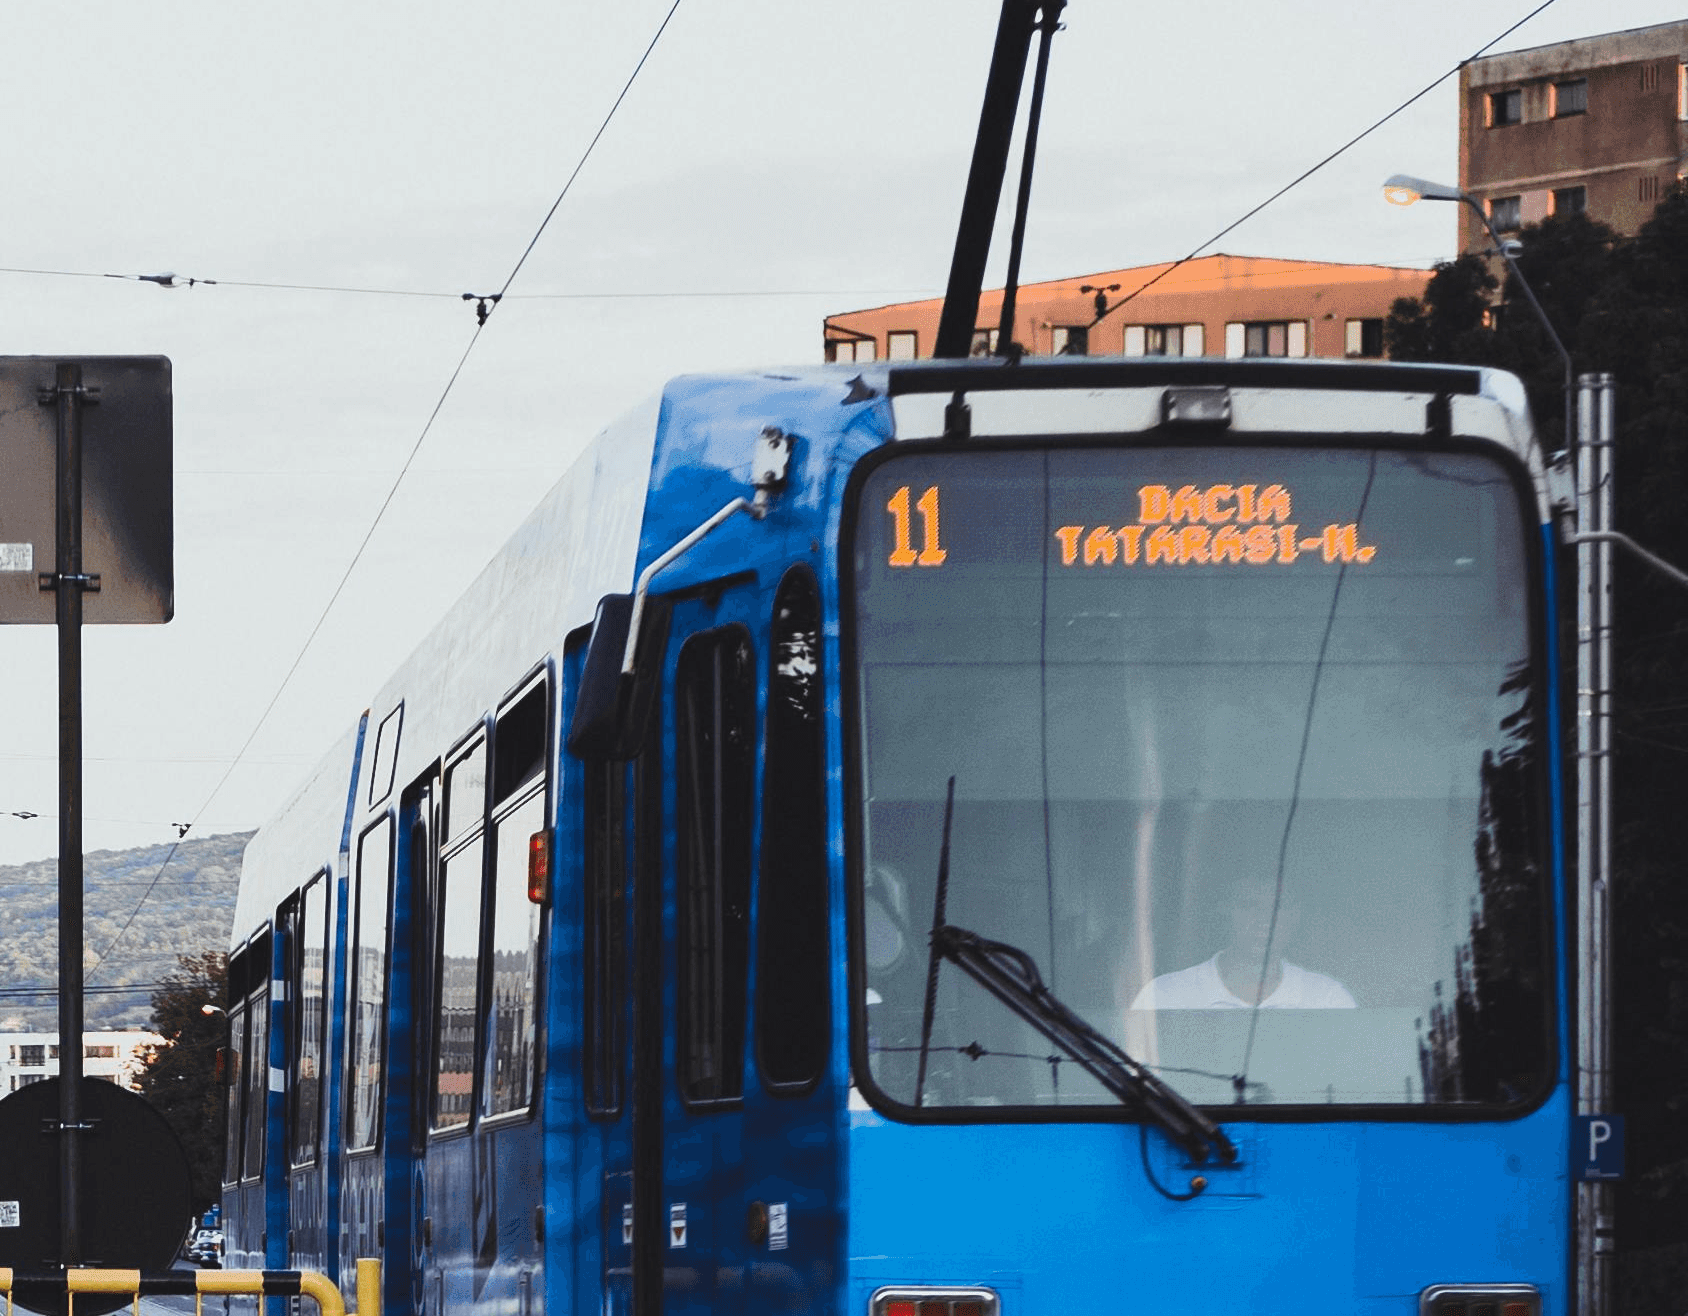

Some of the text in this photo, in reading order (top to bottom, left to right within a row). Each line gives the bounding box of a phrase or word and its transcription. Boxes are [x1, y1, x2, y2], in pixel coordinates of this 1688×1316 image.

[1138, 484, 1292, 523] DACIA
[887, 485, 947, 566] 11
[1589, 1120, 1612, 1161] P
